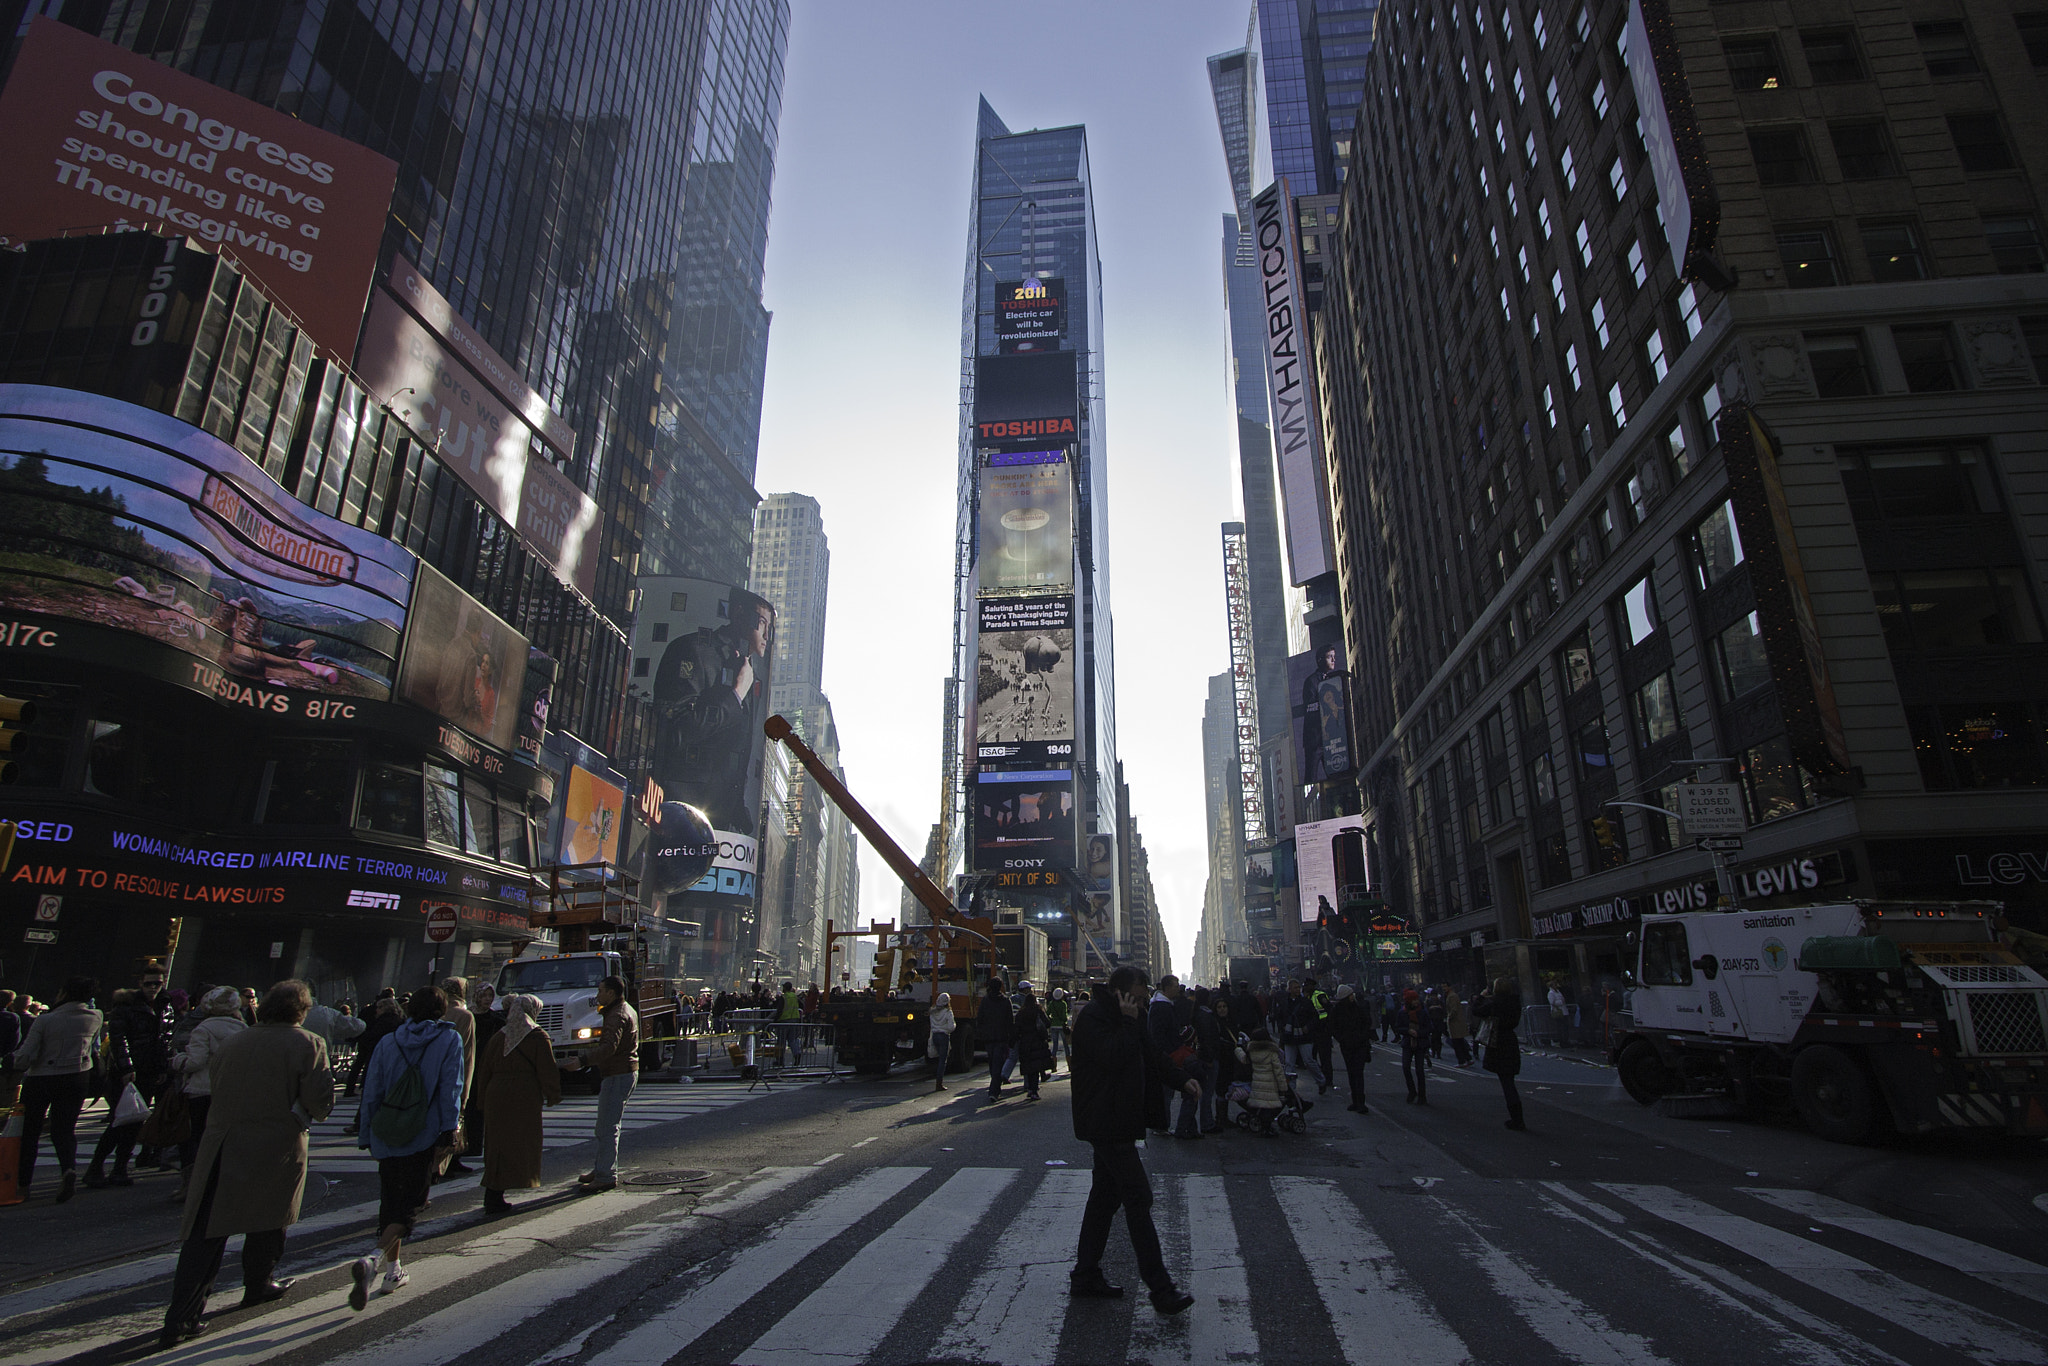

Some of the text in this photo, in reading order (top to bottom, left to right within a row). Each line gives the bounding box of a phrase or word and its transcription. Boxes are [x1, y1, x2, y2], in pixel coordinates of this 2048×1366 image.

[92, 69, 335, 184] Congress
[75, 107, 325, 213] should carve
[63, 135, 320, 240] spending like a
[54, 159, 313, 272] Thanksgiving
[131, 240, 179, 346] 1500
[1014, 286, 1046, 300] 2011
[1000, 298, 1058, 310] TOSHIBA
[1005, 310, 1038, 319] Electric
[1255, 188, 1308, 456] MYHABIT.COM
[1016, 320, 1043, 329] will be
[1001, 329, 1059, 340] revolutionized
[484, 356, 506, 381] now
[410, 336, 500, 432] Before we
[979, 418, 1075, 438] TOSHIBA
[531, 458, 571, 500] Congress
[529, 481, 557, 514] cut
[982, 613, 1006, 621] Macy's
[1007, 611, 1053, 620] Thanksgiving
[1025, 603, 1043, 611] years
[1019, 619, 1039, 627] Times
[1040, 618, 1065, 626] Square
[192, 662, 291, 714] TUESDAYS
[438, 725, 481, 765] TUESDAYS
[979, 747, 1005, 757] TSAC
[1047, 744, 1072, 756] 1940
[641, 776, 664, 824] JVC
[1274, 750, 1287, 833] RICOH
[1688, 788, 1695, 796] W
[1717, 787, 1729, 795] ST
[1690, 797, 1730, 806] CLOSED
[1689, 807, 1736, 815] SAT-SUN
[112, 829, 171, 858] WOMAN
[170, 843, 255, 870] CHARGED
[259, 852, 270, 868] IN
[272, 851, 350, 871] AIRLINE
[356, 857, 413, 880] TERROR
[416, 865, 448, 885] HOAX
[1004, 858, 1046, 868] SONY
[10, 864, 286, 904] AIM TO RESOLVE LAWSUITS
[1027, 871, 1040, 885] OF
[346, 888, 401, 911] ESPN
[500, 884, 527, 902] MOTHER
[433, 911, 454, 920] DO NOT
[461, 905, 486, 922] CLAIM
[1743, 914, 1796, 930] sanitation
[431, 928, 449, 936] ENTER
